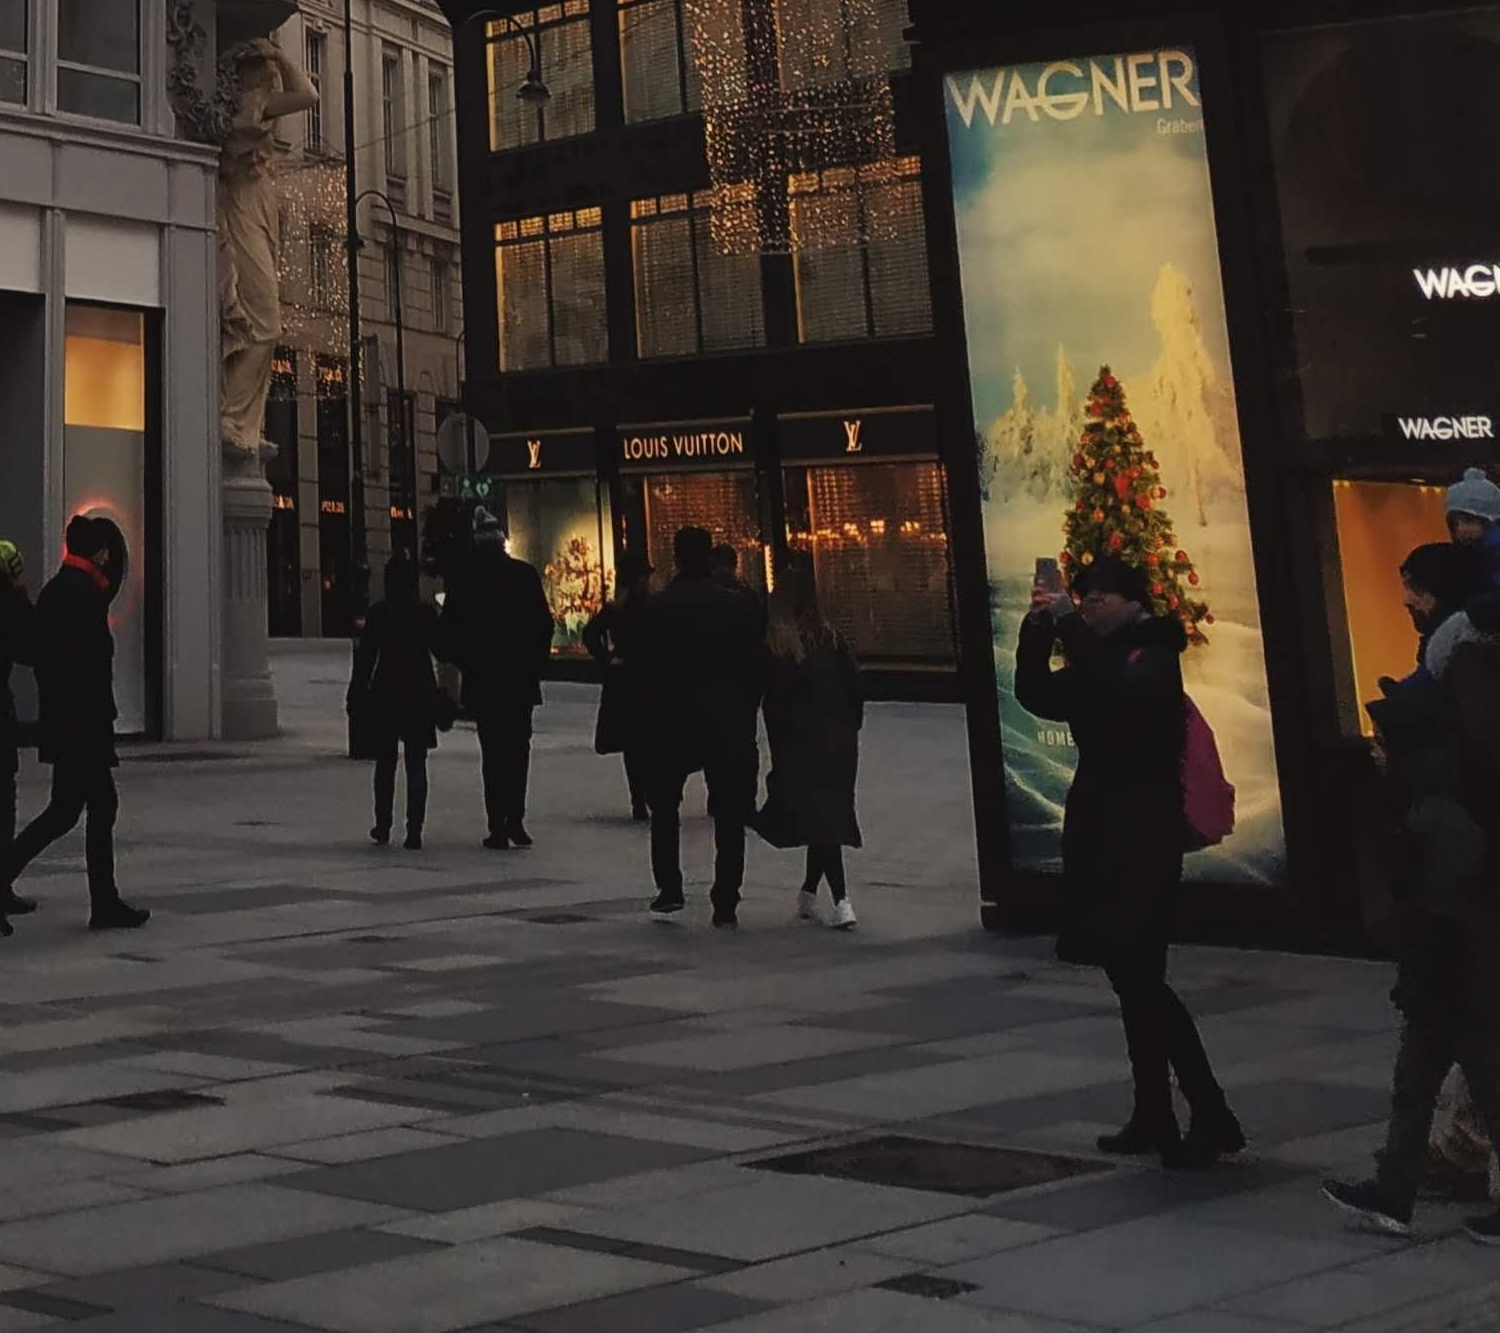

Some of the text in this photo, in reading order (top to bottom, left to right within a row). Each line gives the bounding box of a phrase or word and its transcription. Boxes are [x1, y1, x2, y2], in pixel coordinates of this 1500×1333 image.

[946, 51, 1201, 129] WAGNER
[1397, 415, 1495, 441] WAGNER
[623, 432, 743, 459] LOUIS VUITTON
